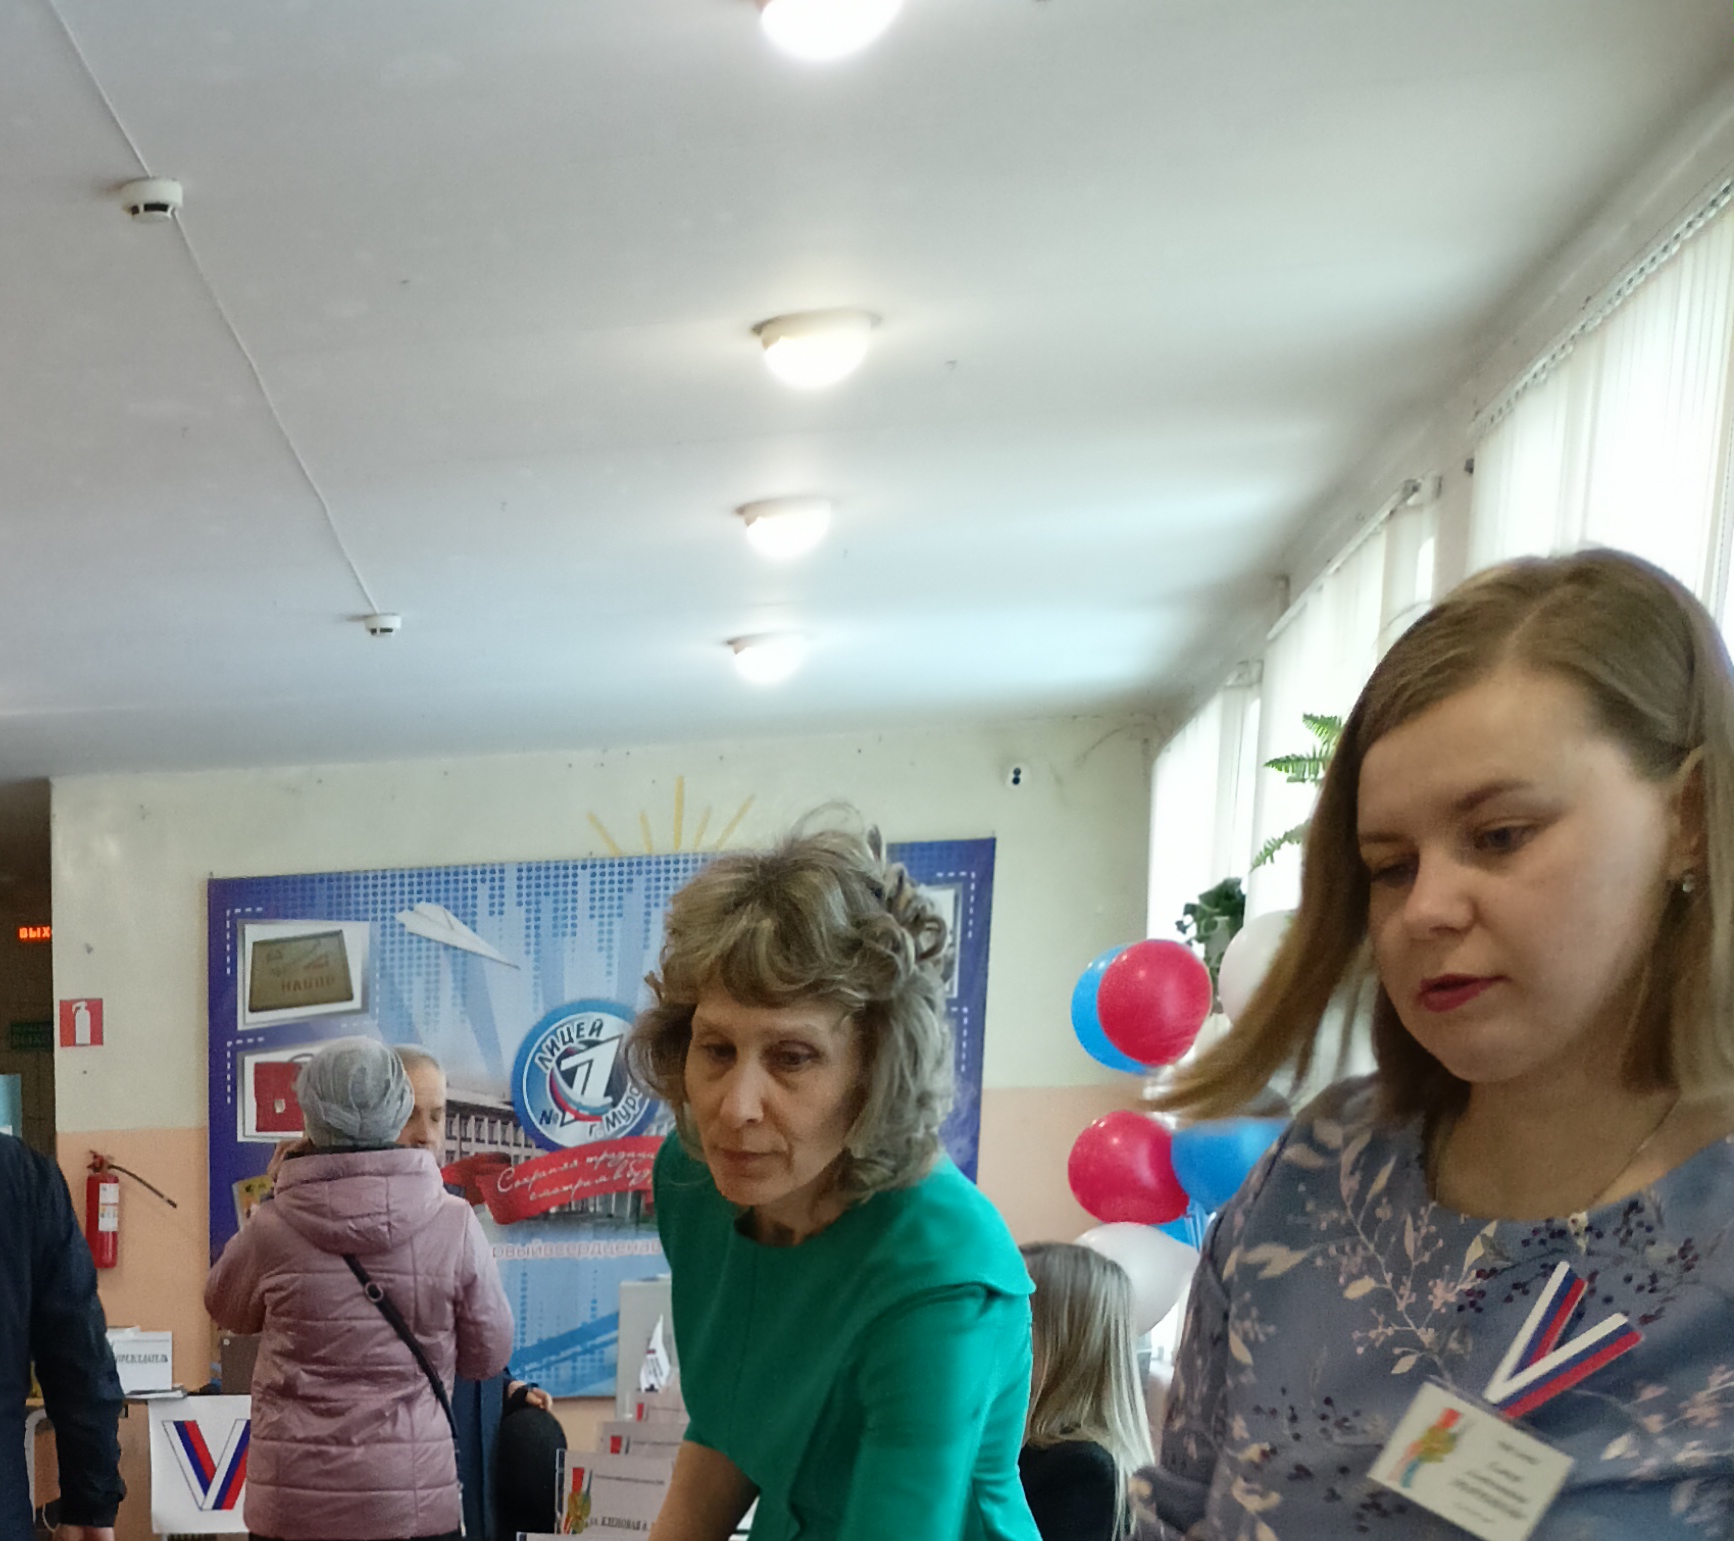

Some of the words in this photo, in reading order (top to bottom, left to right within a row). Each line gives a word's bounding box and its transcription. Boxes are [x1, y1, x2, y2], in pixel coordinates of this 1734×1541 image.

[18, 926, 52, 939] ВЫХ
[536, 1018, 604, 1071] ЛИЦЕЙ
[605, 1086, 643, 1133] Муро
[497, 1158, 579, 1194] Сохраняя
[586, 1149, 656, 1171] традици
[627, 1159, 652, 1188] буд
